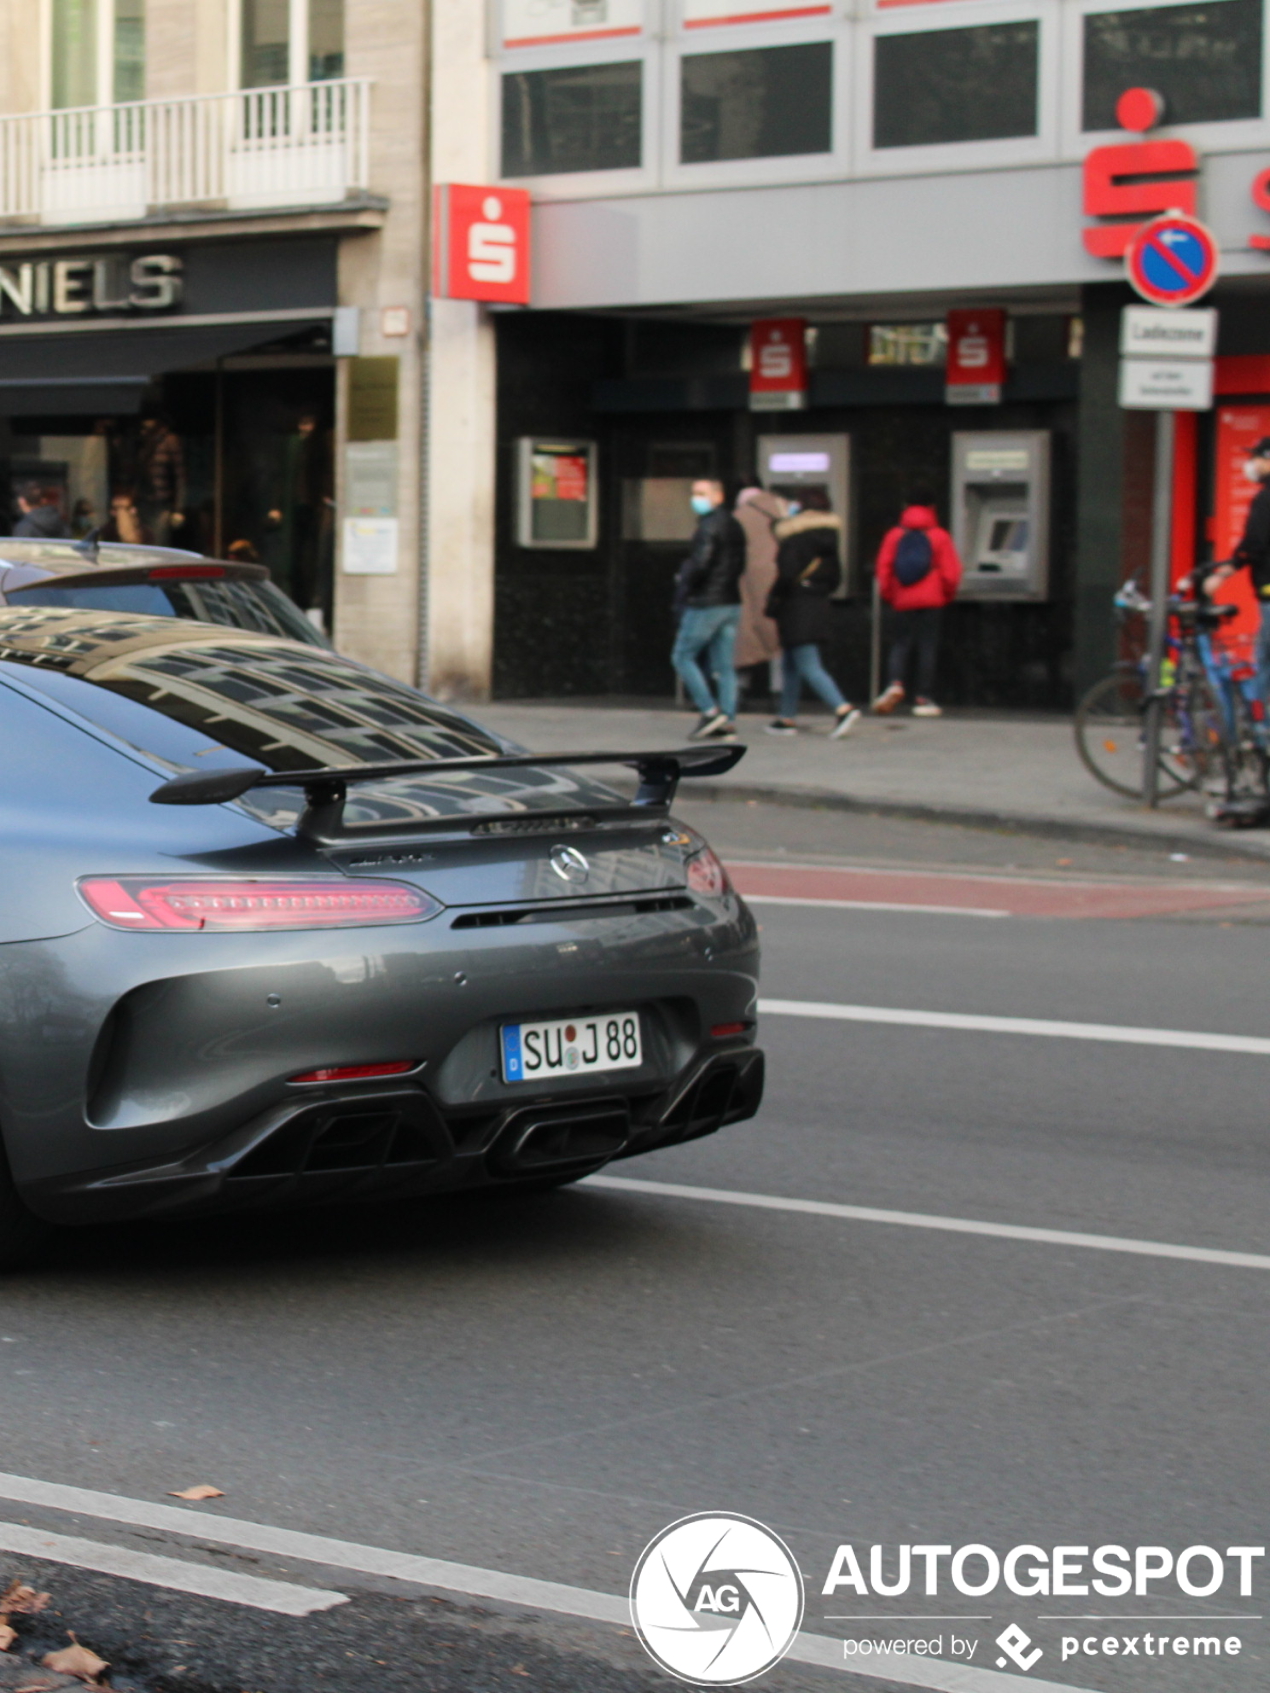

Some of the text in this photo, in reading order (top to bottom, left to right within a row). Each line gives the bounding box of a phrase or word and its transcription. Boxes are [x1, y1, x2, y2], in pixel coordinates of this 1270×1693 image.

[524, 1027, 563, 1071] SU
[582, 1023, 598, 1064] J
[606, 1018, 637, 1061] 88
